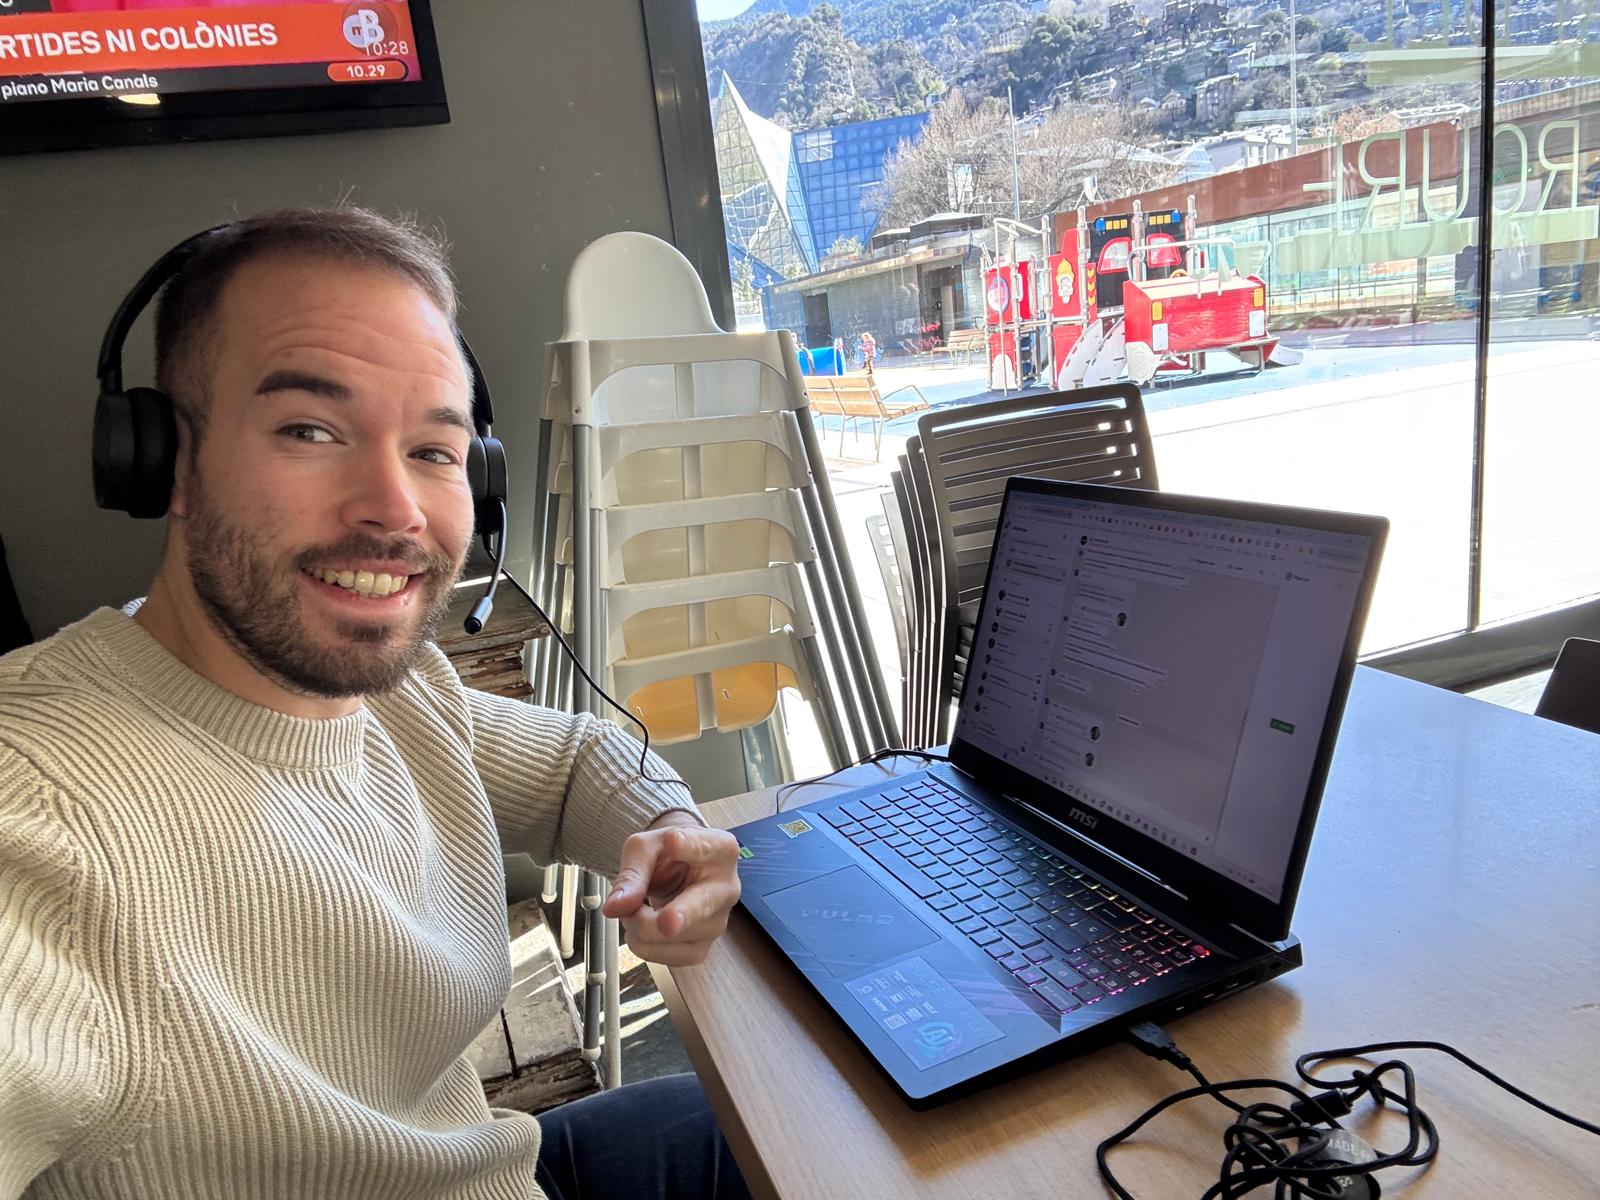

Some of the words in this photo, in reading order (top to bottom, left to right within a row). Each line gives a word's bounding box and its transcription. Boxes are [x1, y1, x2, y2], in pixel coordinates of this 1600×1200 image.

[0, 30, 102, 59] RTIDES
[105, 27, 136, 53] NI
[144, 21, 278, 52] COLÒNIES
[364, 40, 409, 56] 10:28
[346, 64, 386, 78] 10.29
[1, 81, 49, 100] piano
[50, 77, 99, 94] Maria
[101, 74, 158, 91] Canals
[1068, 807, 1099, 829] msi
